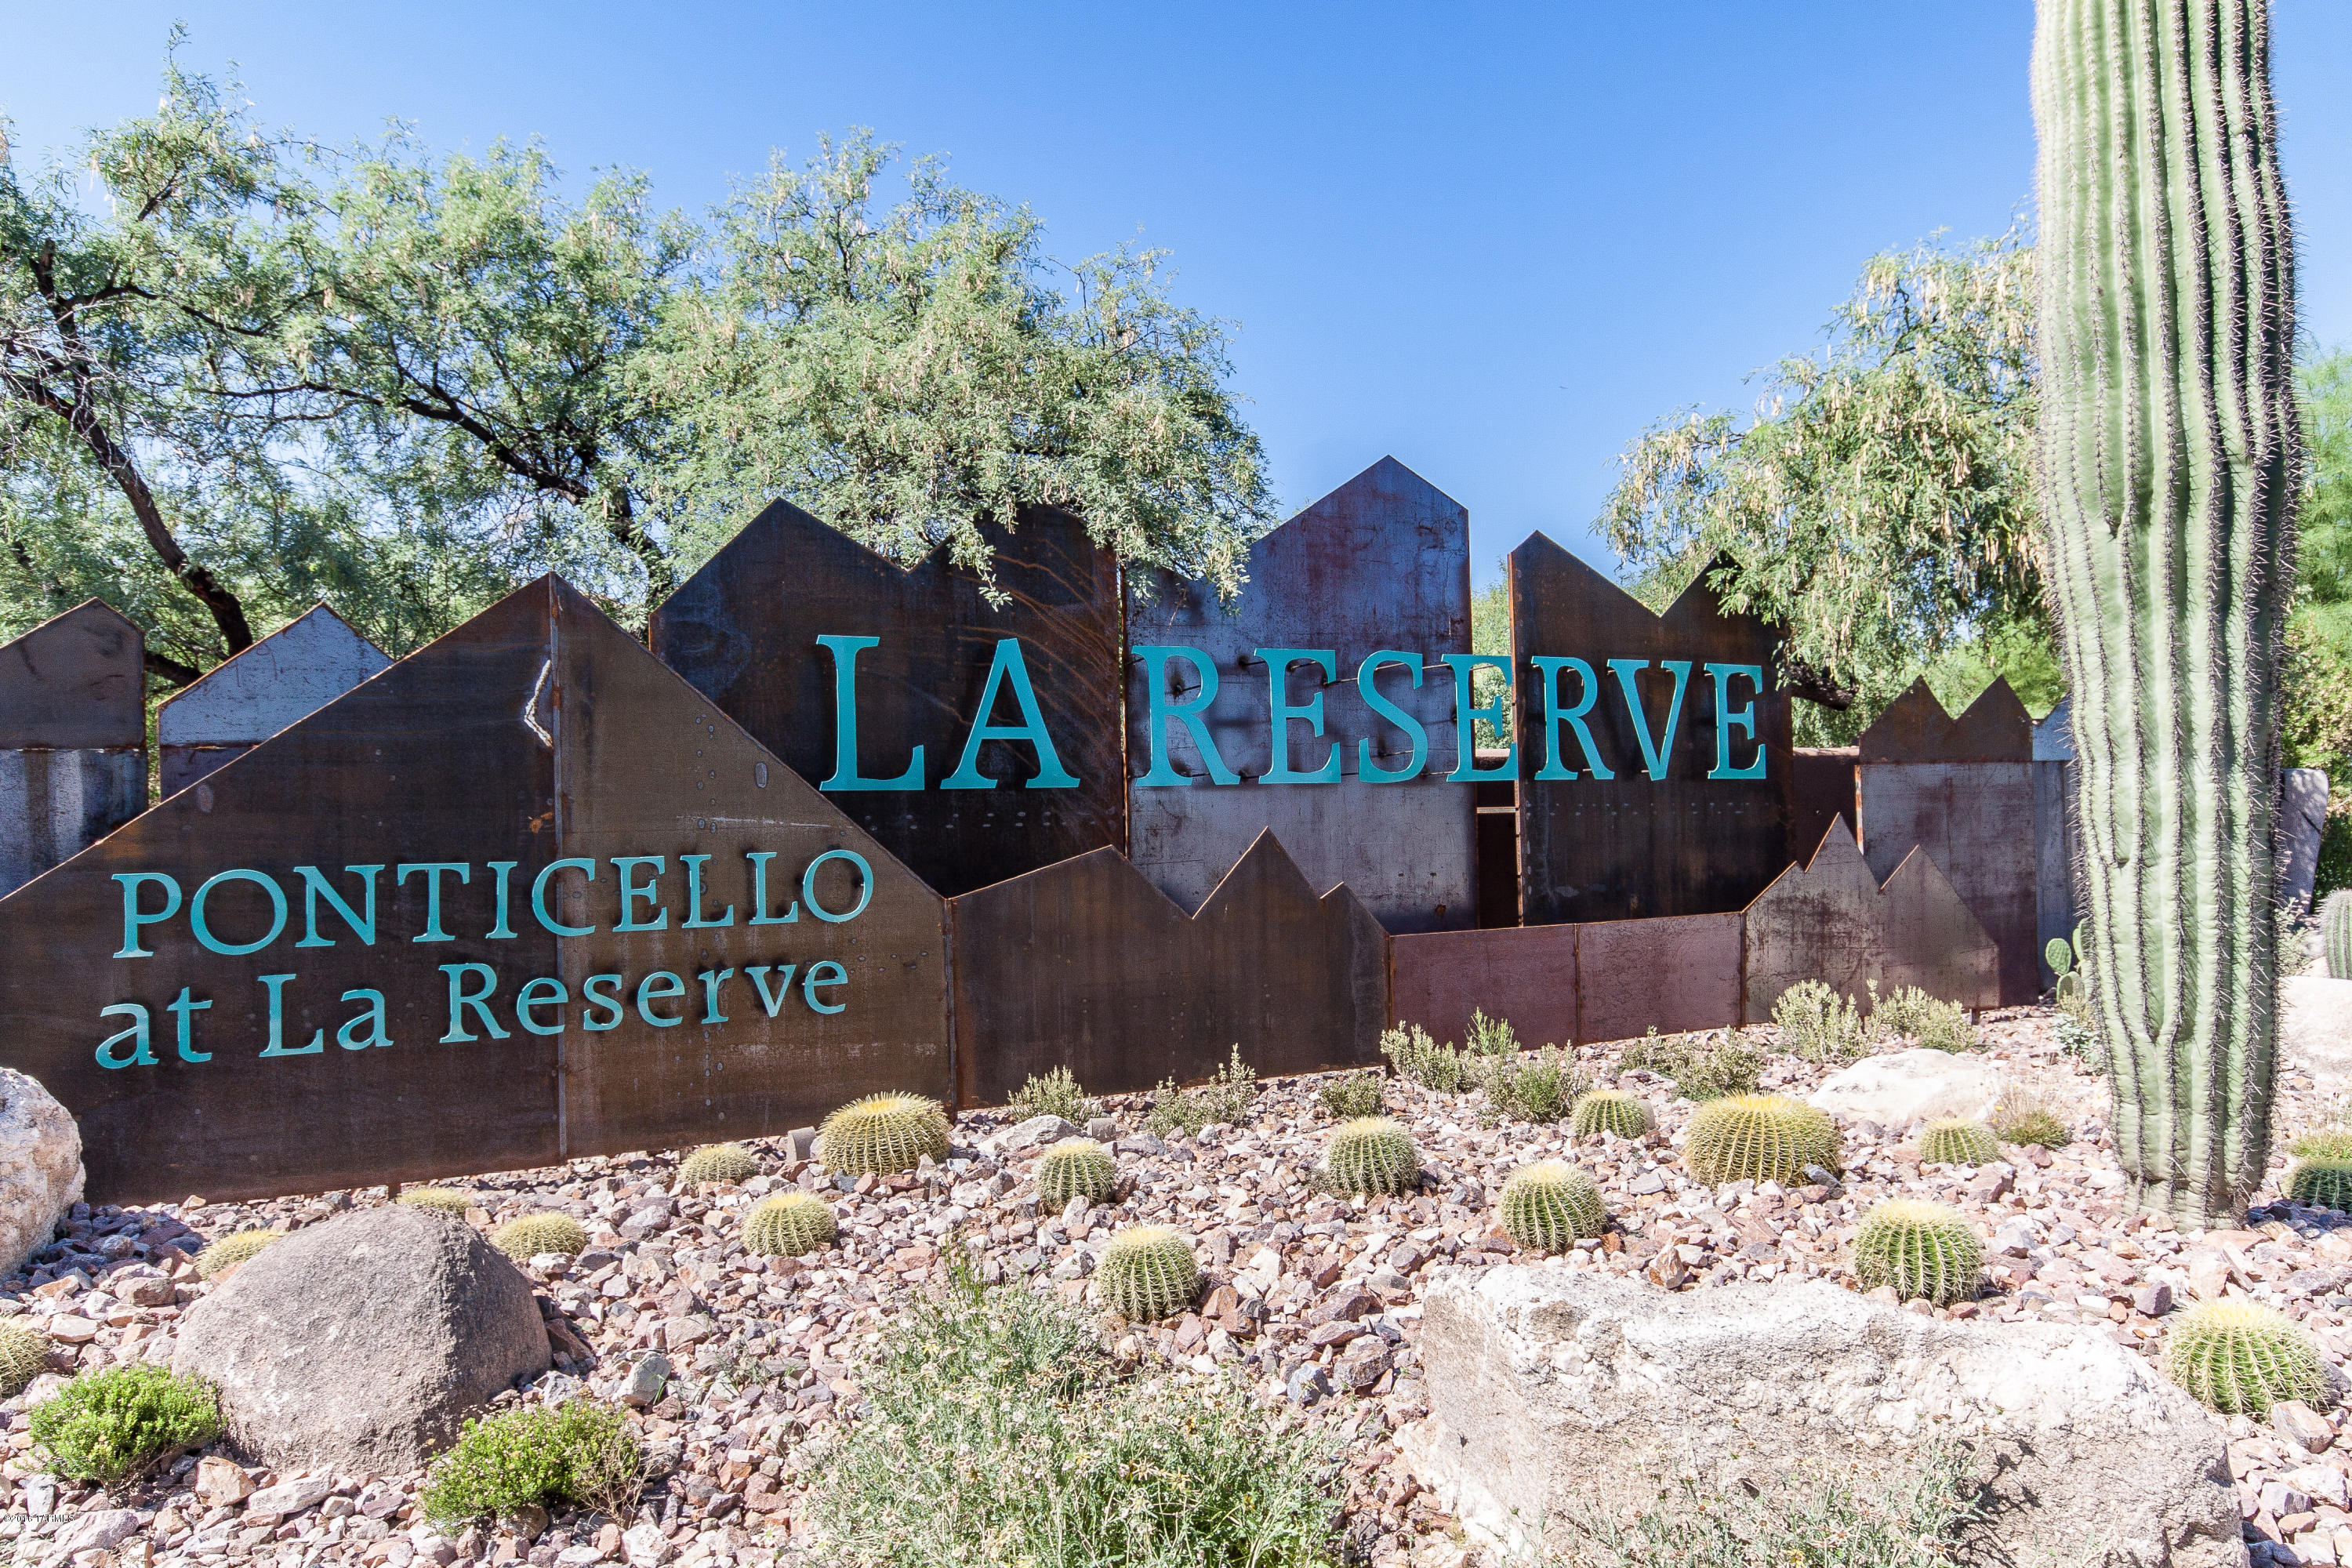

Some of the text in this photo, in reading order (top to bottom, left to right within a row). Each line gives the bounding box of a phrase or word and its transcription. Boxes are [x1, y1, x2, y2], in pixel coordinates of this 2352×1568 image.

[815, 634, 1767, 791] LA RESERVE
[111, 849, 874, 959] PONTICELLO
[95, 960, 849, 1069] at La Reserve
